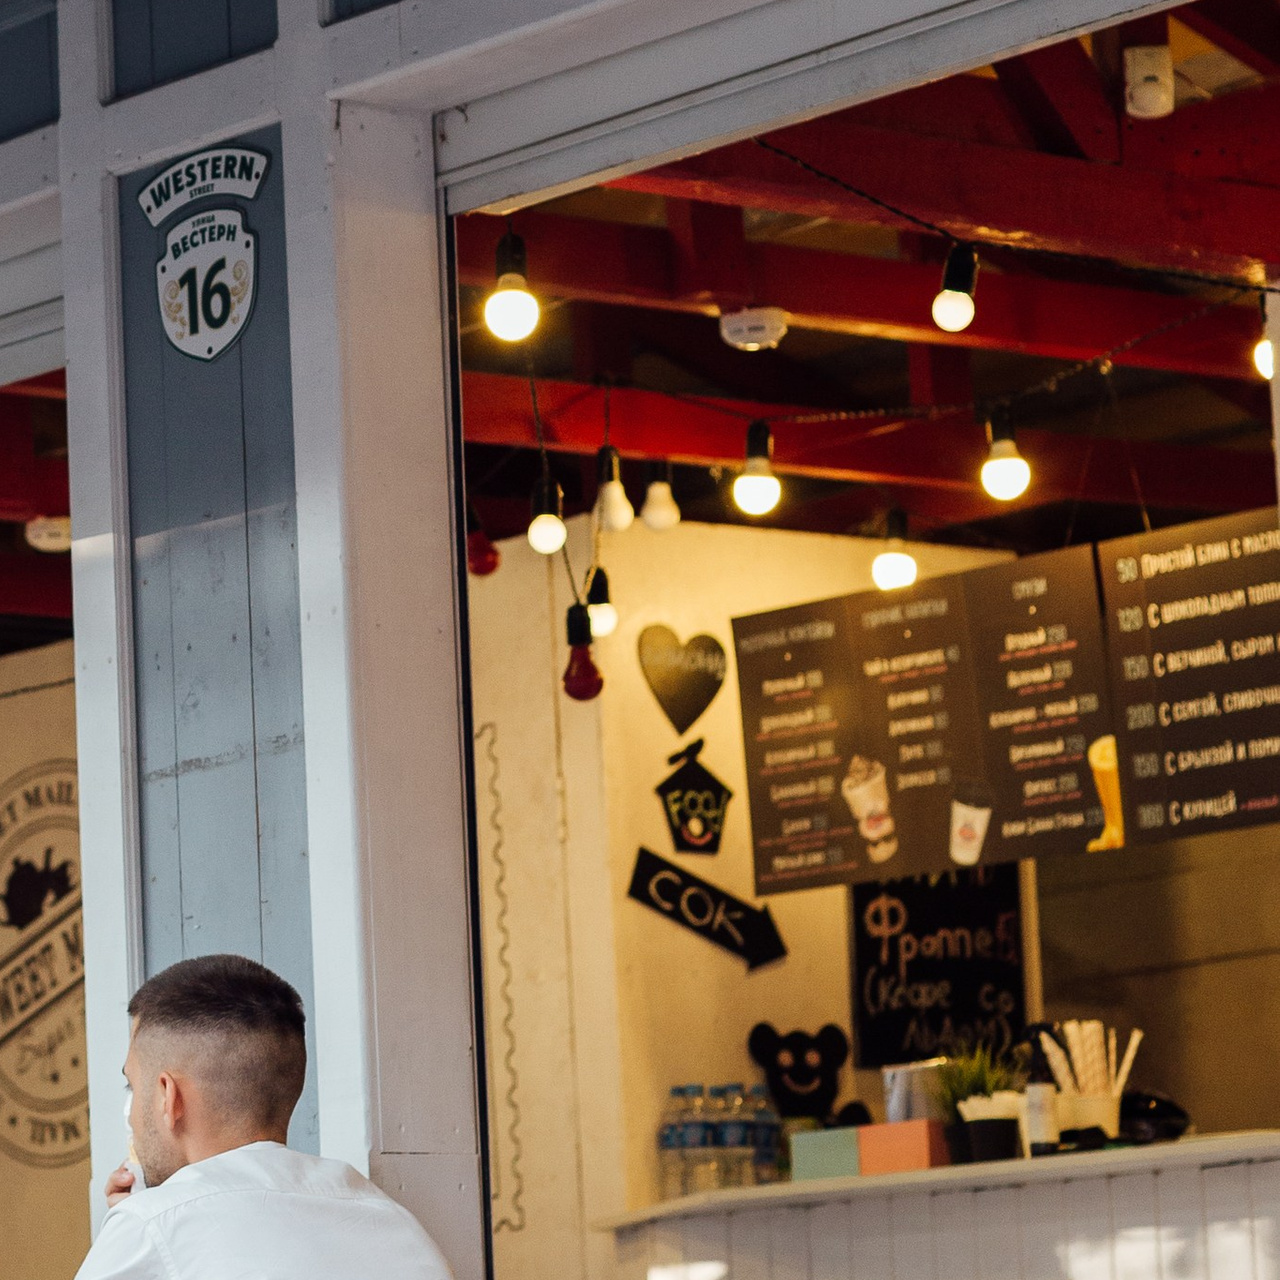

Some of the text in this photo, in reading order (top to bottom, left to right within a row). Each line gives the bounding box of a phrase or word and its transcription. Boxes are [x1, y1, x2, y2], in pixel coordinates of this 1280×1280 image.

[150, 154, 255, 209] WESTERN
[189, 183, 215, 199] STREET
[171, 224, 237, 260] ВЕСТЕРН
[178, 256, 231, 336] 16
